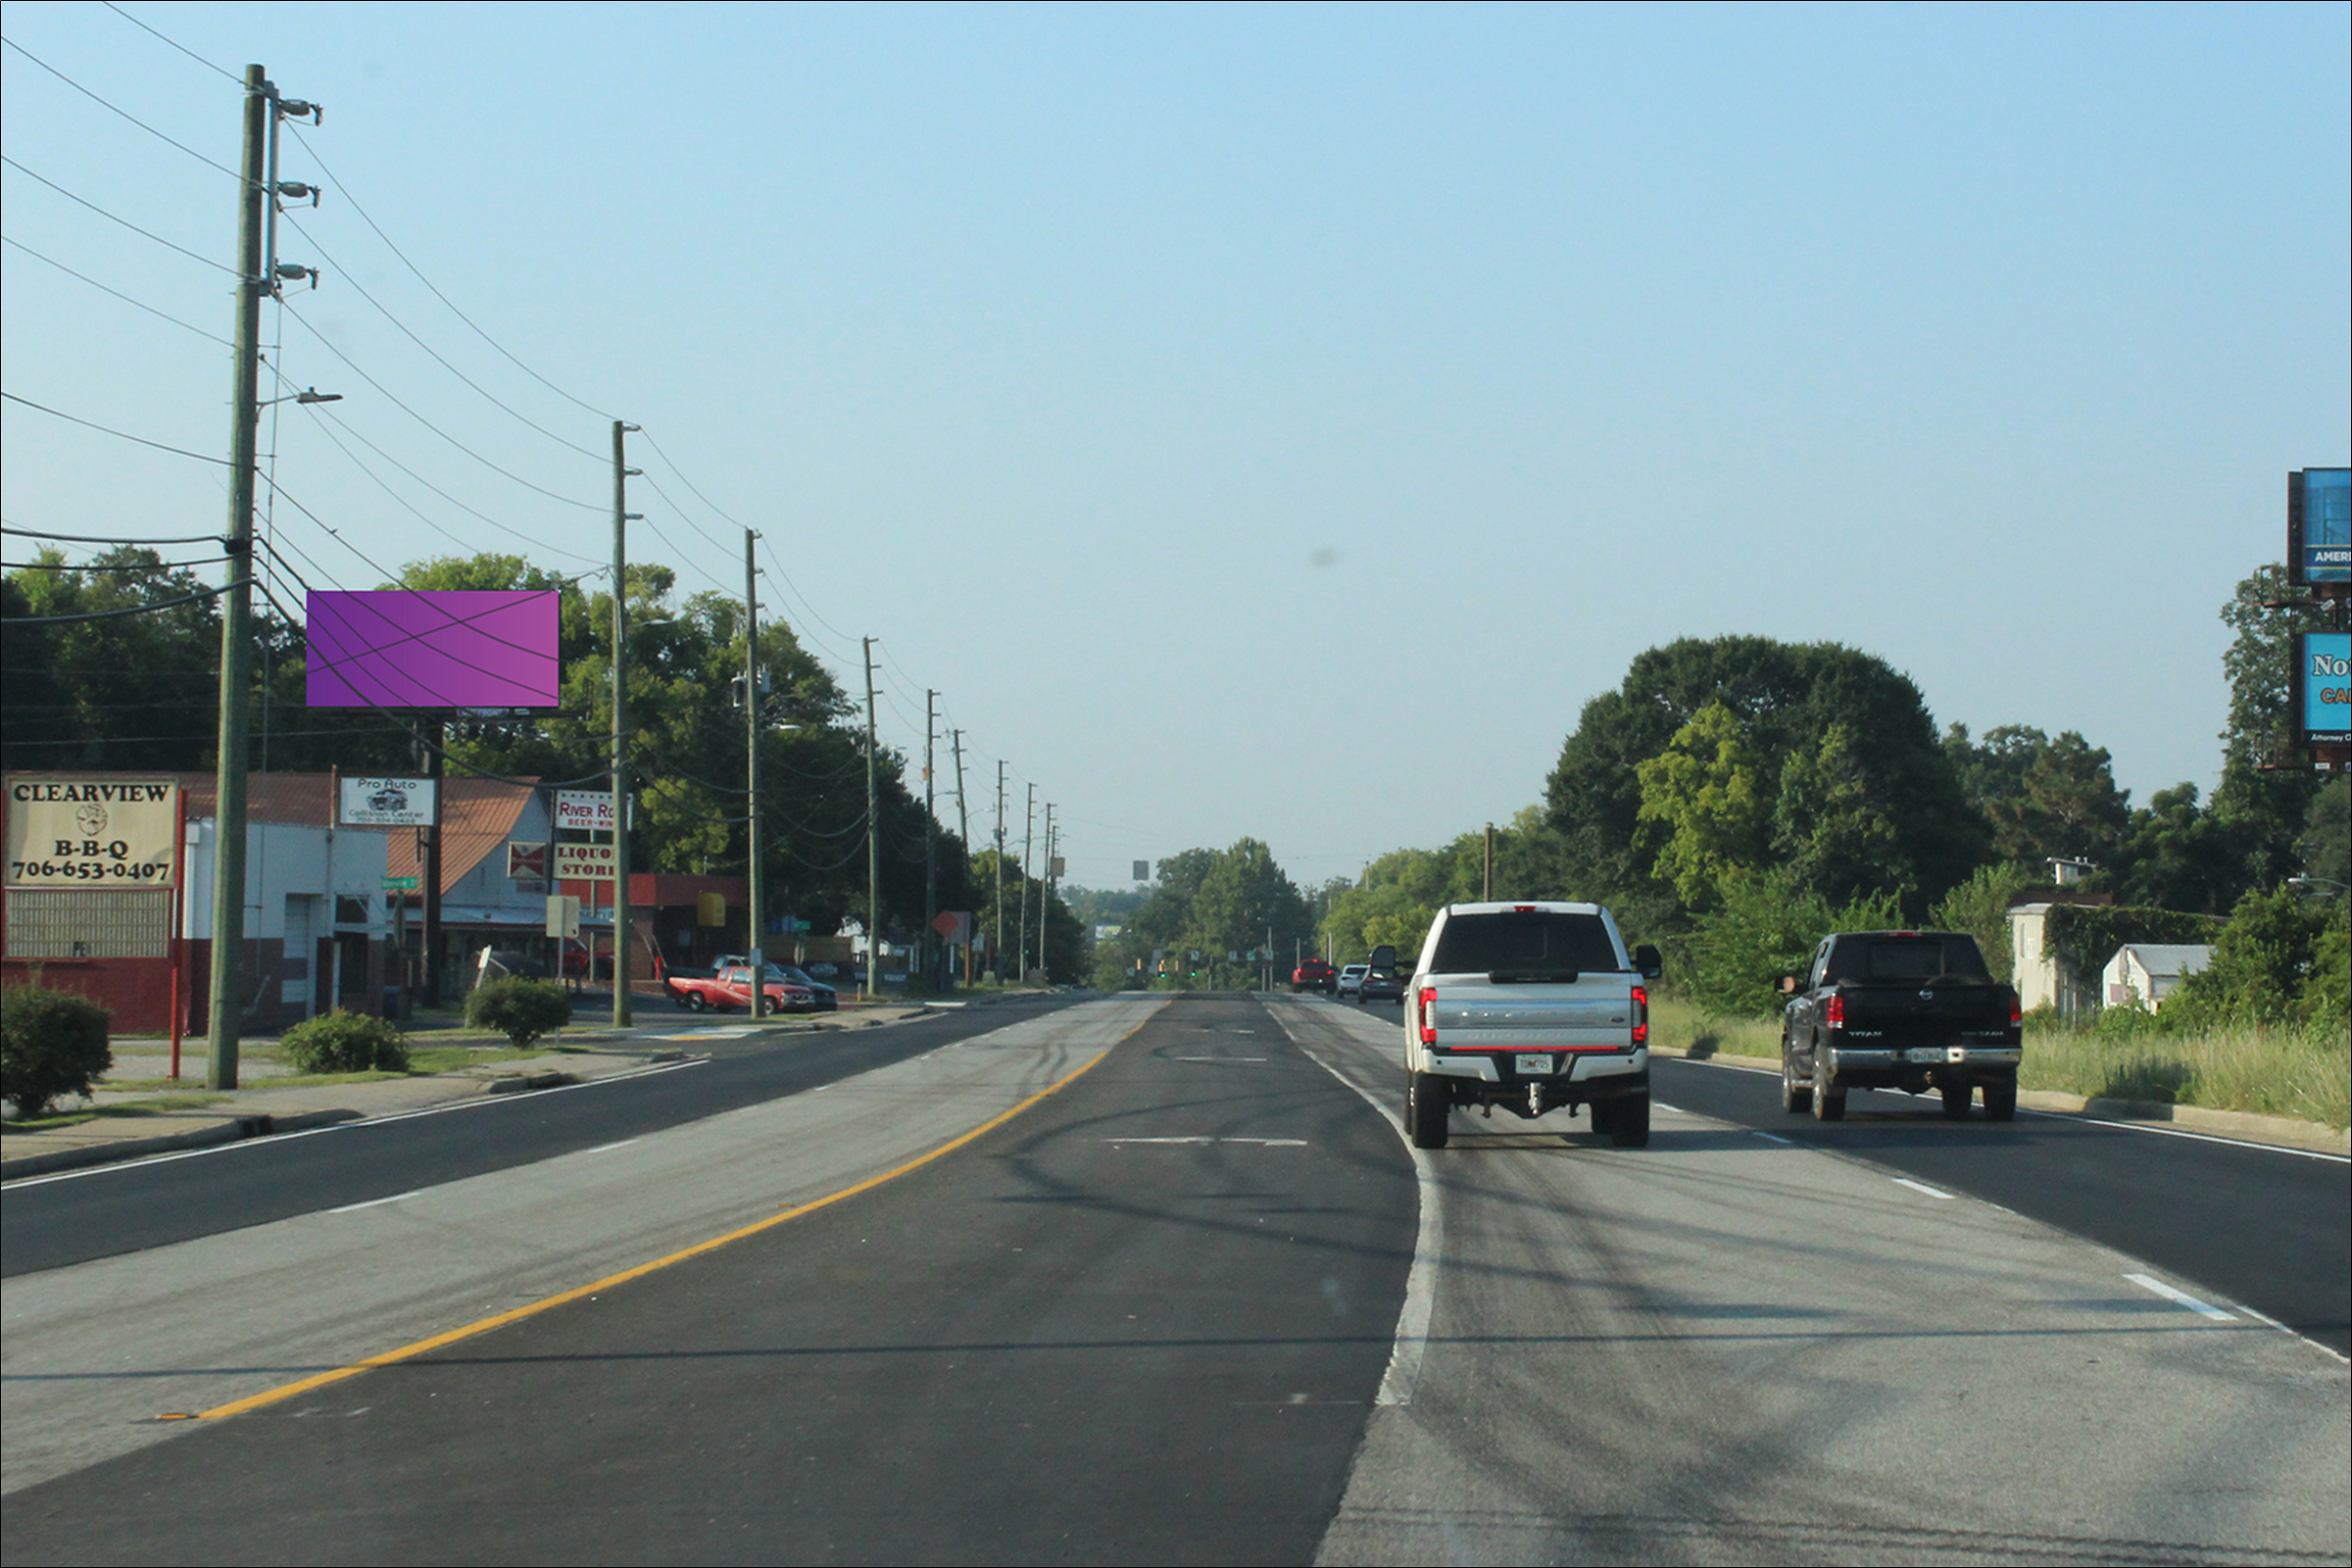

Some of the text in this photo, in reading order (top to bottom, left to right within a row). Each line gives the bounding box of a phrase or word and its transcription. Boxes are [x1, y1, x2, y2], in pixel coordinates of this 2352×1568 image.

[2311, 733, 2343, 743] Attorney
[358, 777, 416, 790] Pro Auto
[14, 784, 169, 803] CLEARVIEW
[349, 809, 423, 818] Collision Center
[560, 802, 613, 818] RIVER RO
[568, 818, 613, 828] BEER-WIN
[55, 840, 128, 859] B-B-Q
[558, 847, 614, 861] LIQUO
[12, 860, 170, 881] 706-653-0407
